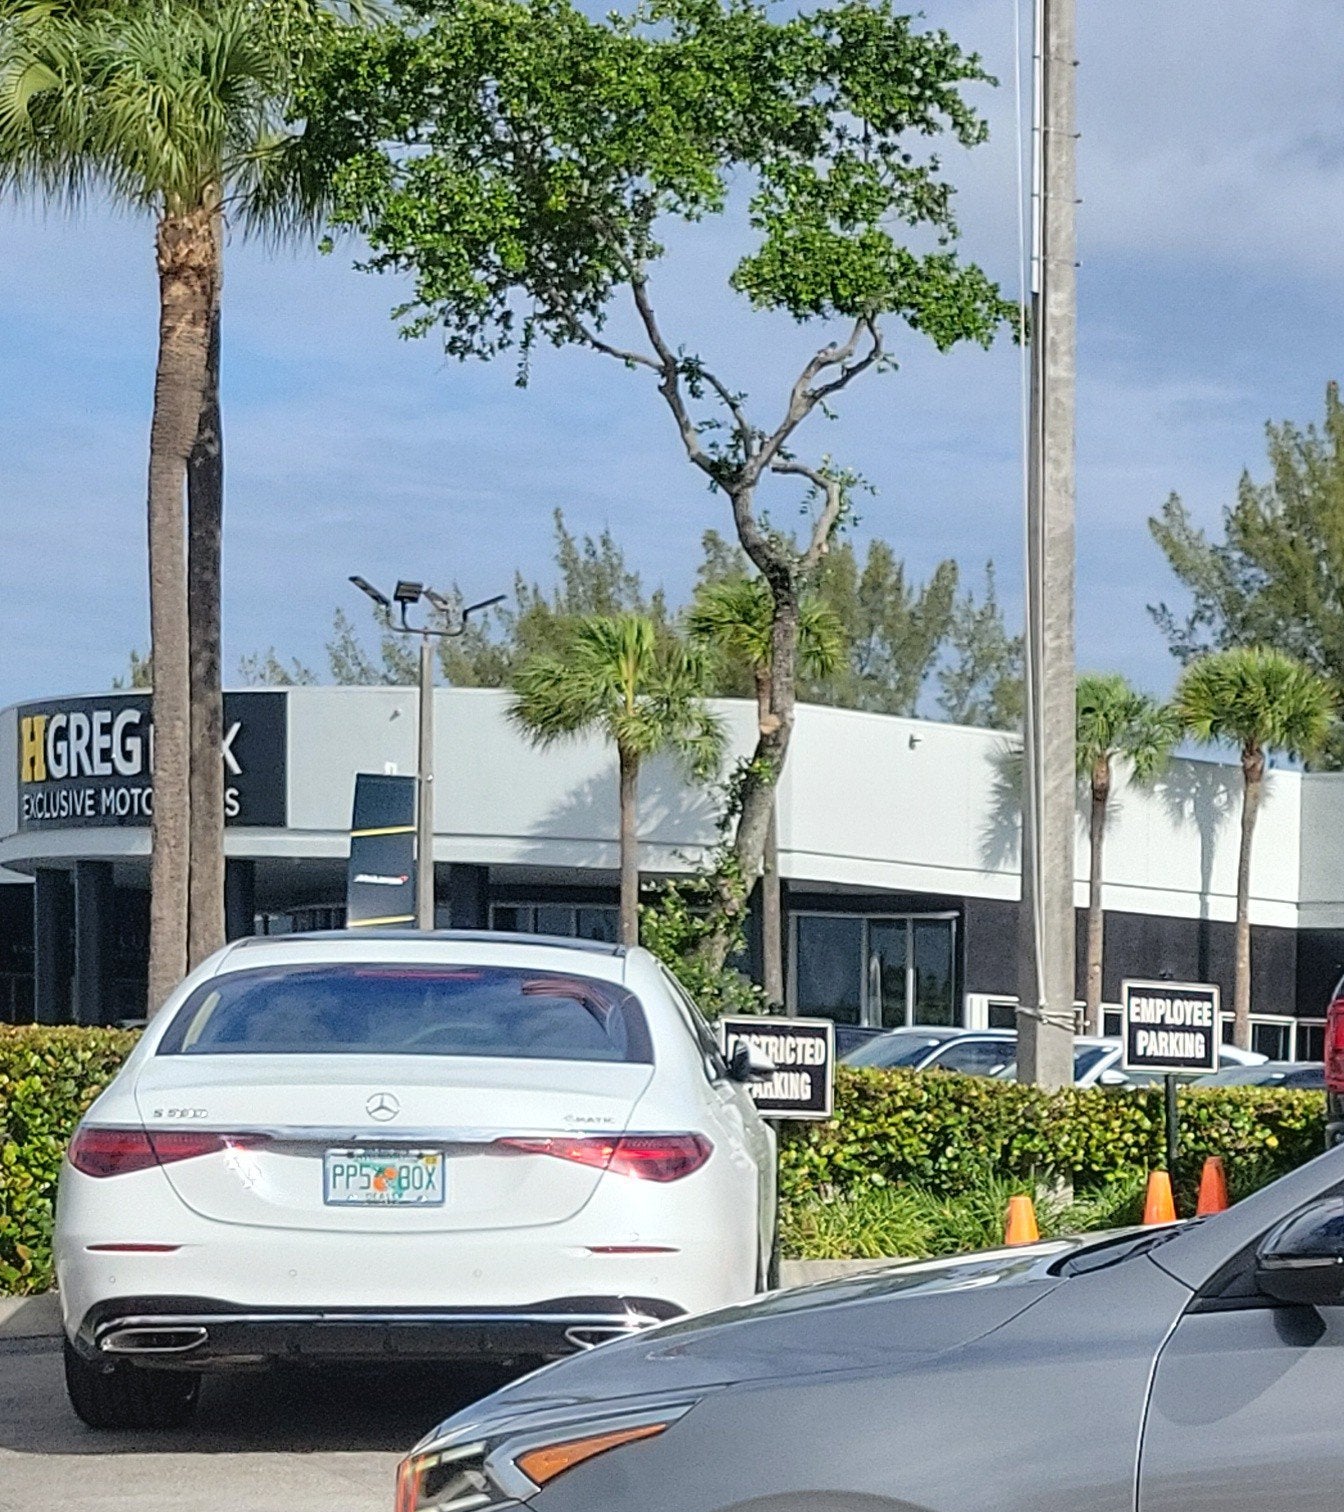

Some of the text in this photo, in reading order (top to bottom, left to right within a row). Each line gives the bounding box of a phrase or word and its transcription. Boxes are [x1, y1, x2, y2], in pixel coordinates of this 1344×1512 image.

[21, 709, 142, 782] HGREG
[24, 789, 96, 820] EXCLUSIVE
[1130, 996, 1212, 1027] EMPLOYEE
[727, 1033, 826, 1066] RTRICTED
[1136, 1030, 1206, 1059] PARKING
